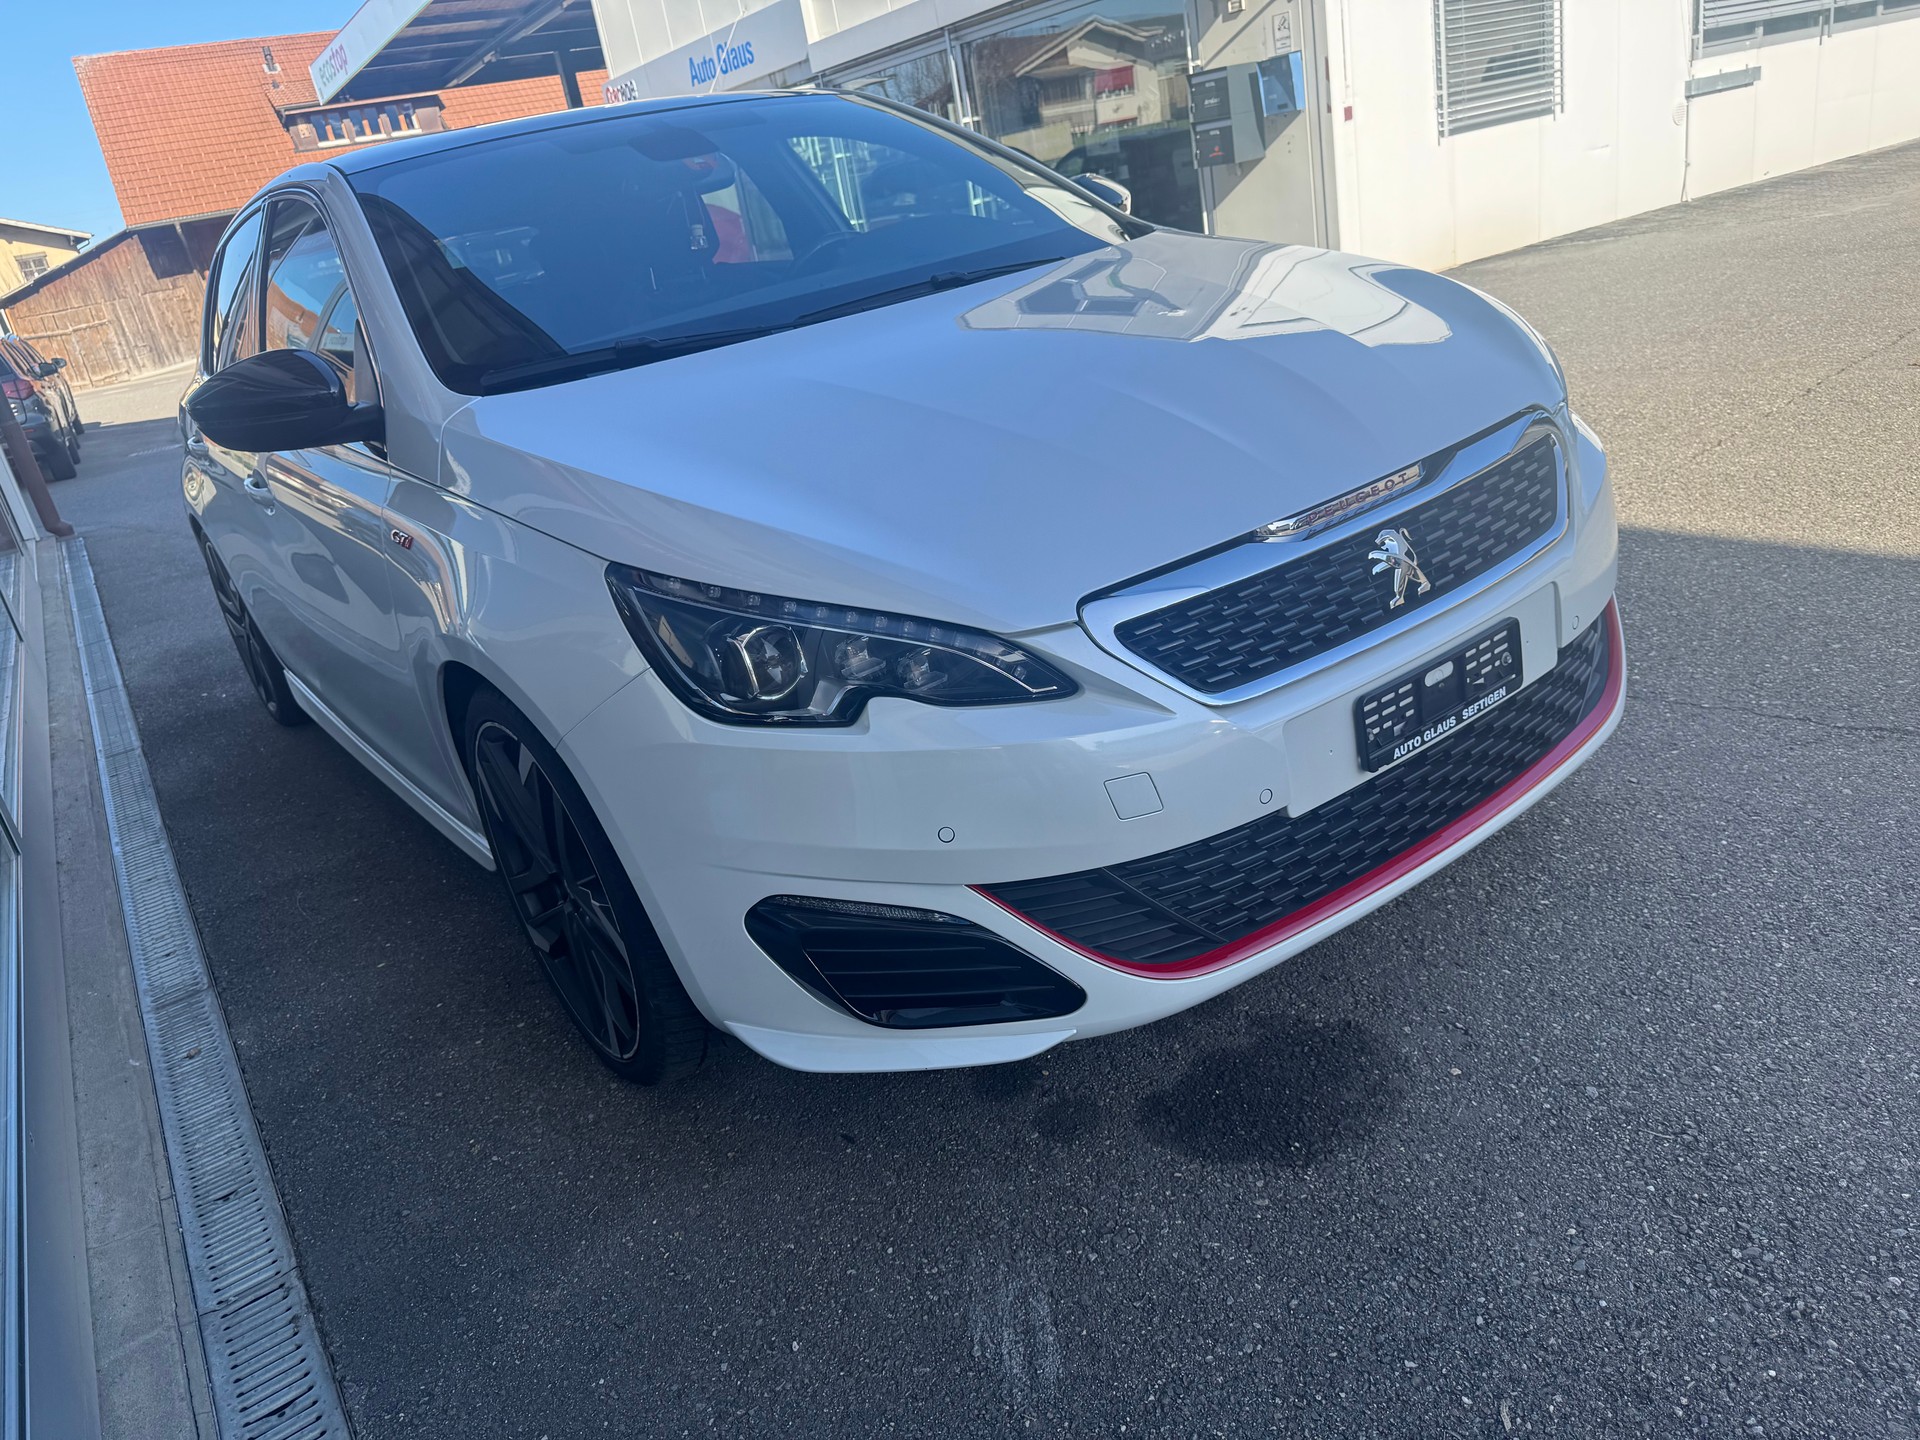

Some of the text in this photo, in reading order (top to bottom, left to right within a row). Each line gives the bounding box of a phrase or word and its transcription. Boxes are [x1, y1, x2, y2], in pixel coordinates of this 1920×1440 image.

[689, 41, 754, 87] Auto Glaus
[1308, 472, 1407, 526] PEUGEOT
[1394, 686, 1506, 760] AUTO GLAUS SEFTIGEN
